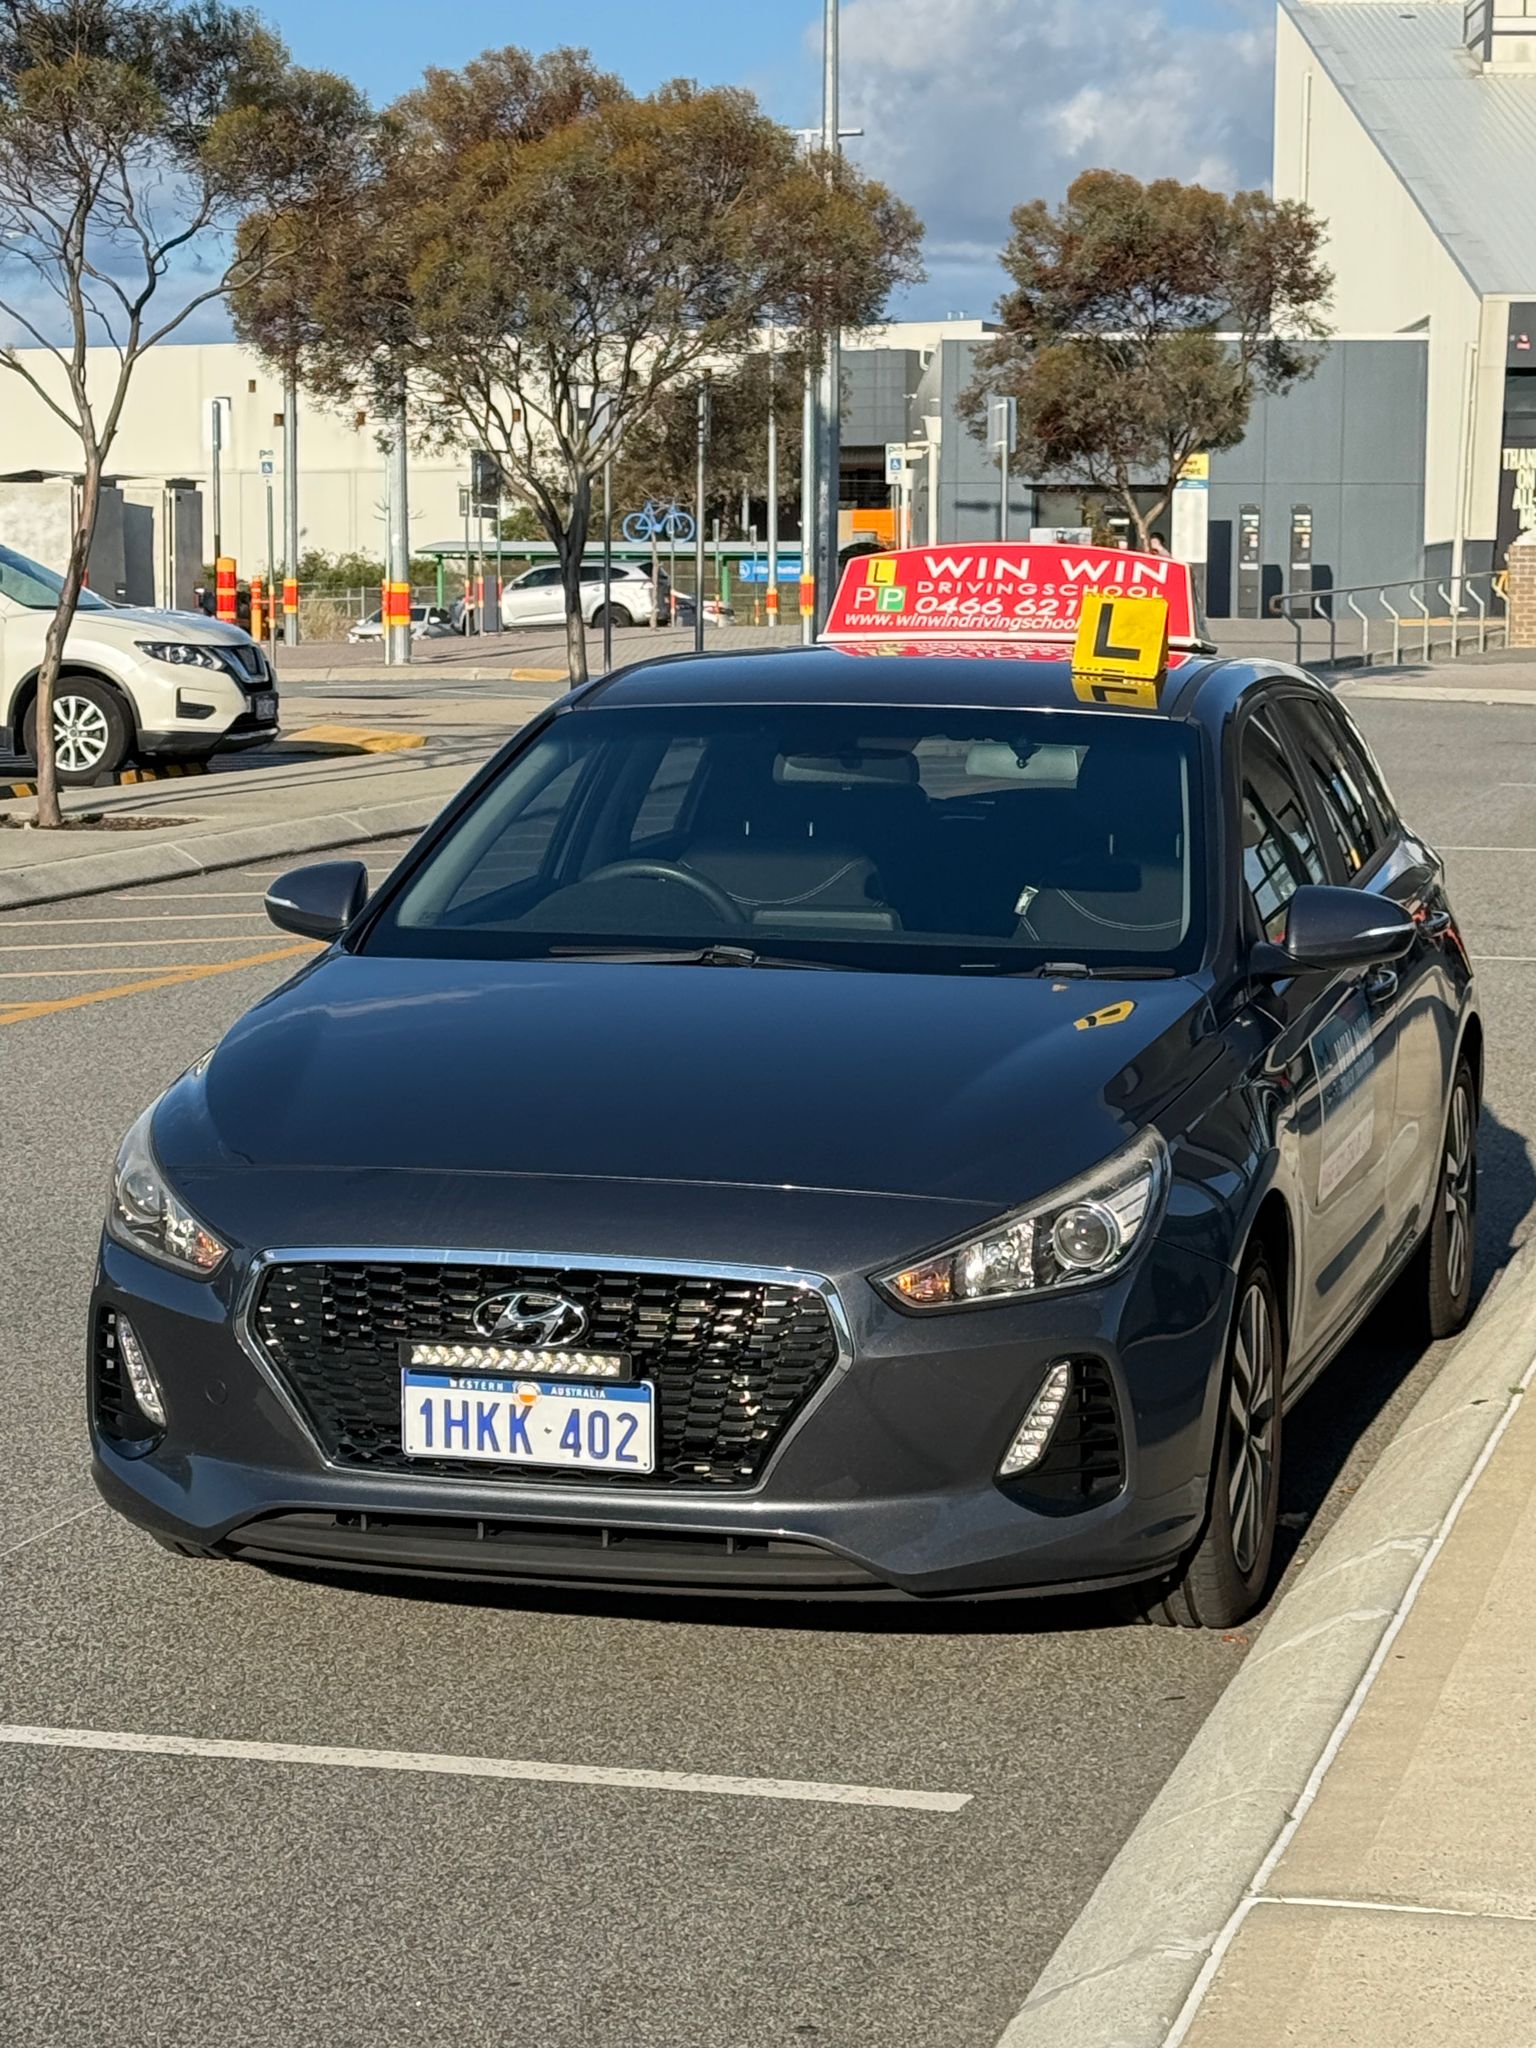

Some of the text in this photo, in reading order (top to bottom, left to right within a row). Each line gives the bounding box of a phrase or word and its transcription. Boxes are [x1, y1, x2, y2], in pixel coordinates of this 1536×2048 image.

[873, 561, 888, 584] L
[923, 556, 1169, 585] WIN WIN
[915, 596, 1079, 617] 0466 621
[1093, 603, 1141, 661] L
[450, 1378, 607, 1399] WESTERN AUSTRALIA
[420, 1398, 639, 1463] 1HKK 402
